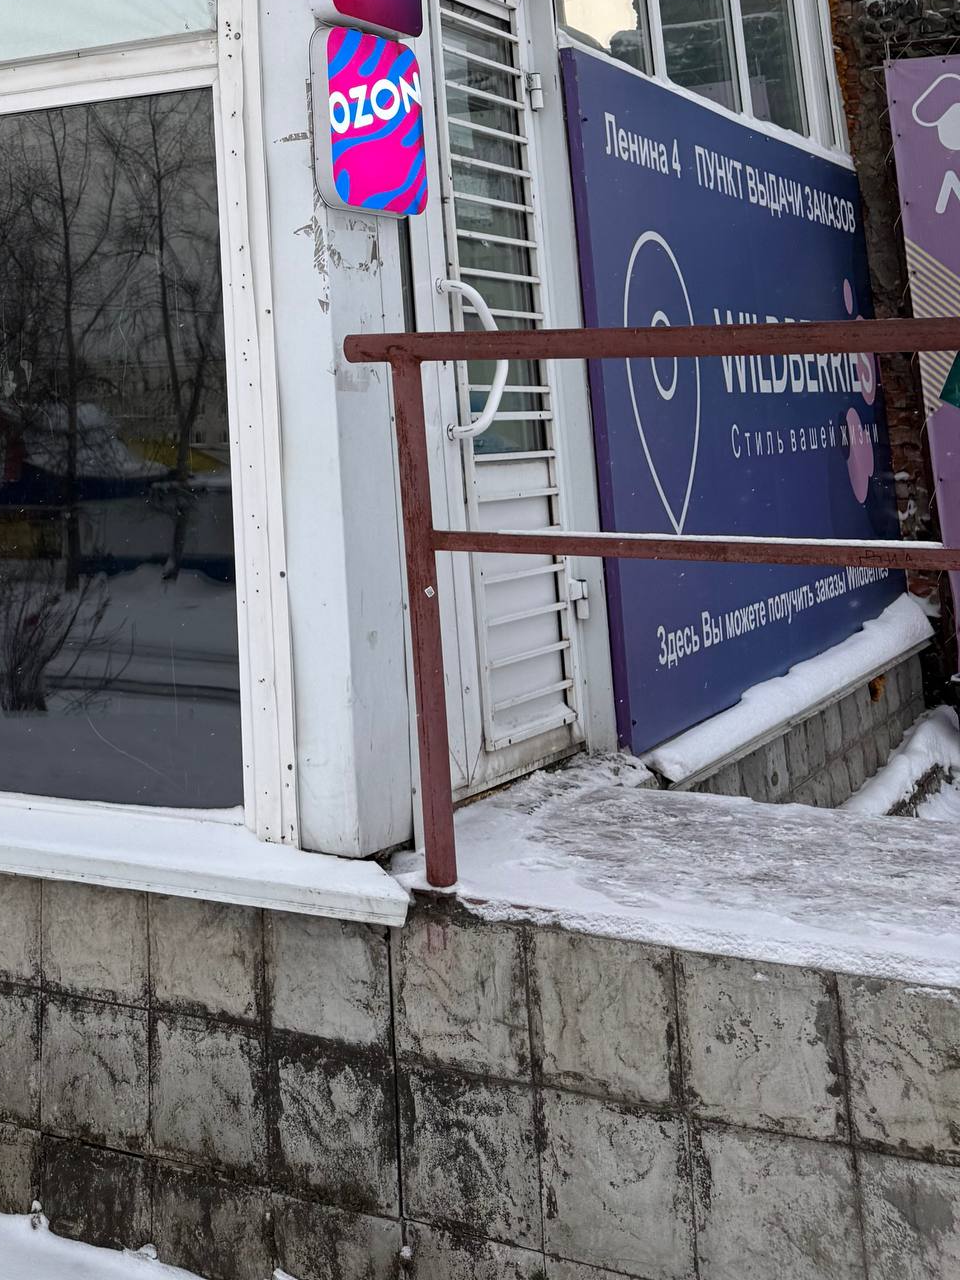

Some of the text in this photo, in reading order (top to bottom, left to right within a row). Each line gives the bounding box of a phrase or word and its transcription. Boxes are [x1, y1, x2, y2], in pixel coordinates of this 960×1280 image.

[329, 72, 423, 134] OZON
[604, 112, 856, 234] Ленина 4 ПУНКТ ВЫДАЧИ ЗАКАЗОВ
[731, 420, 879, 459] Стиль вашей жизни
[657, 625, 700, 669] Здесь
[701, 611, 724, 649] Вы
[725, 600, 767, 637] можете
[767, 584, 815, 625] получить
[815, 572, 847, 603] заказы
